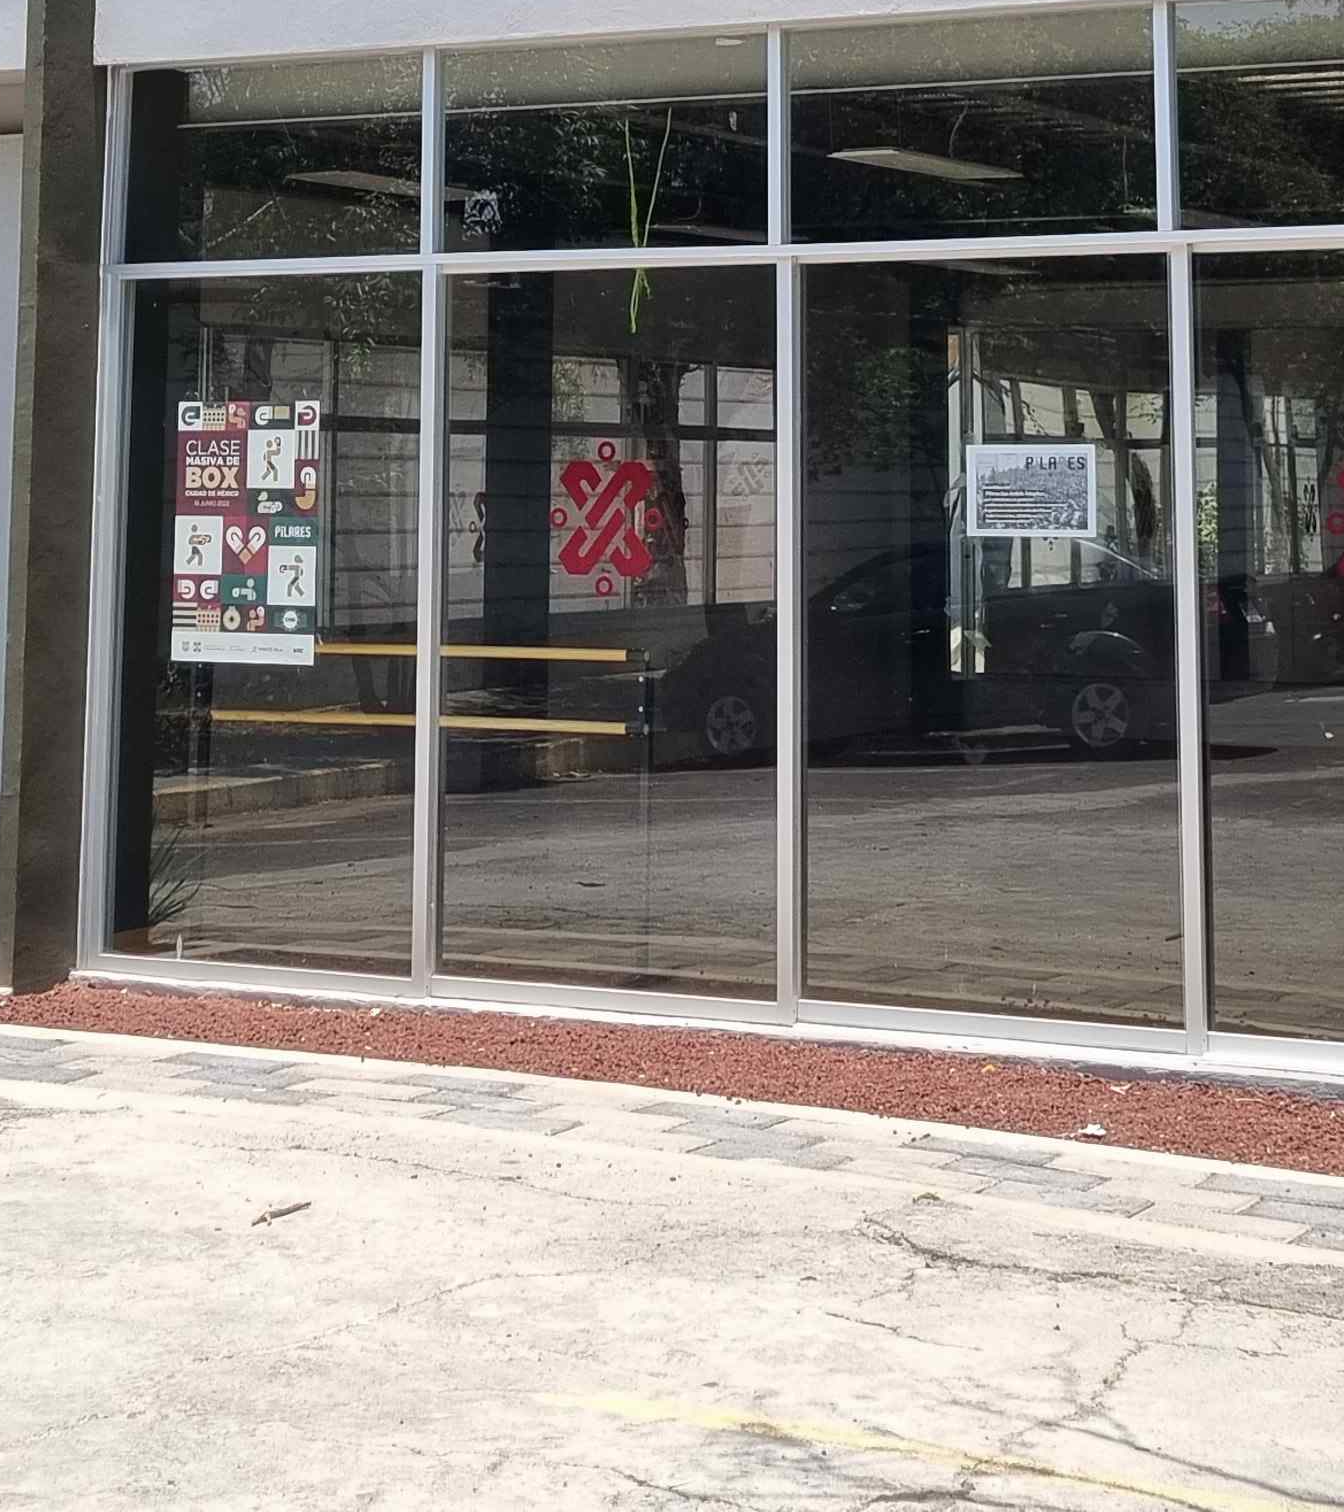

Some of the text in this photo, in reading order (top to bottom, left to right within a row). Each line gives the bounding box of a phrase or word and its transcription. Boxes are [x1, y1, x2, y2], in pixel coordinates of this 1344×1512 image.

[186, 440, 240, 456] CLASE
[185, 456, 240, 466] MASIVA DE
[185, 466, 240, 489] BOX
